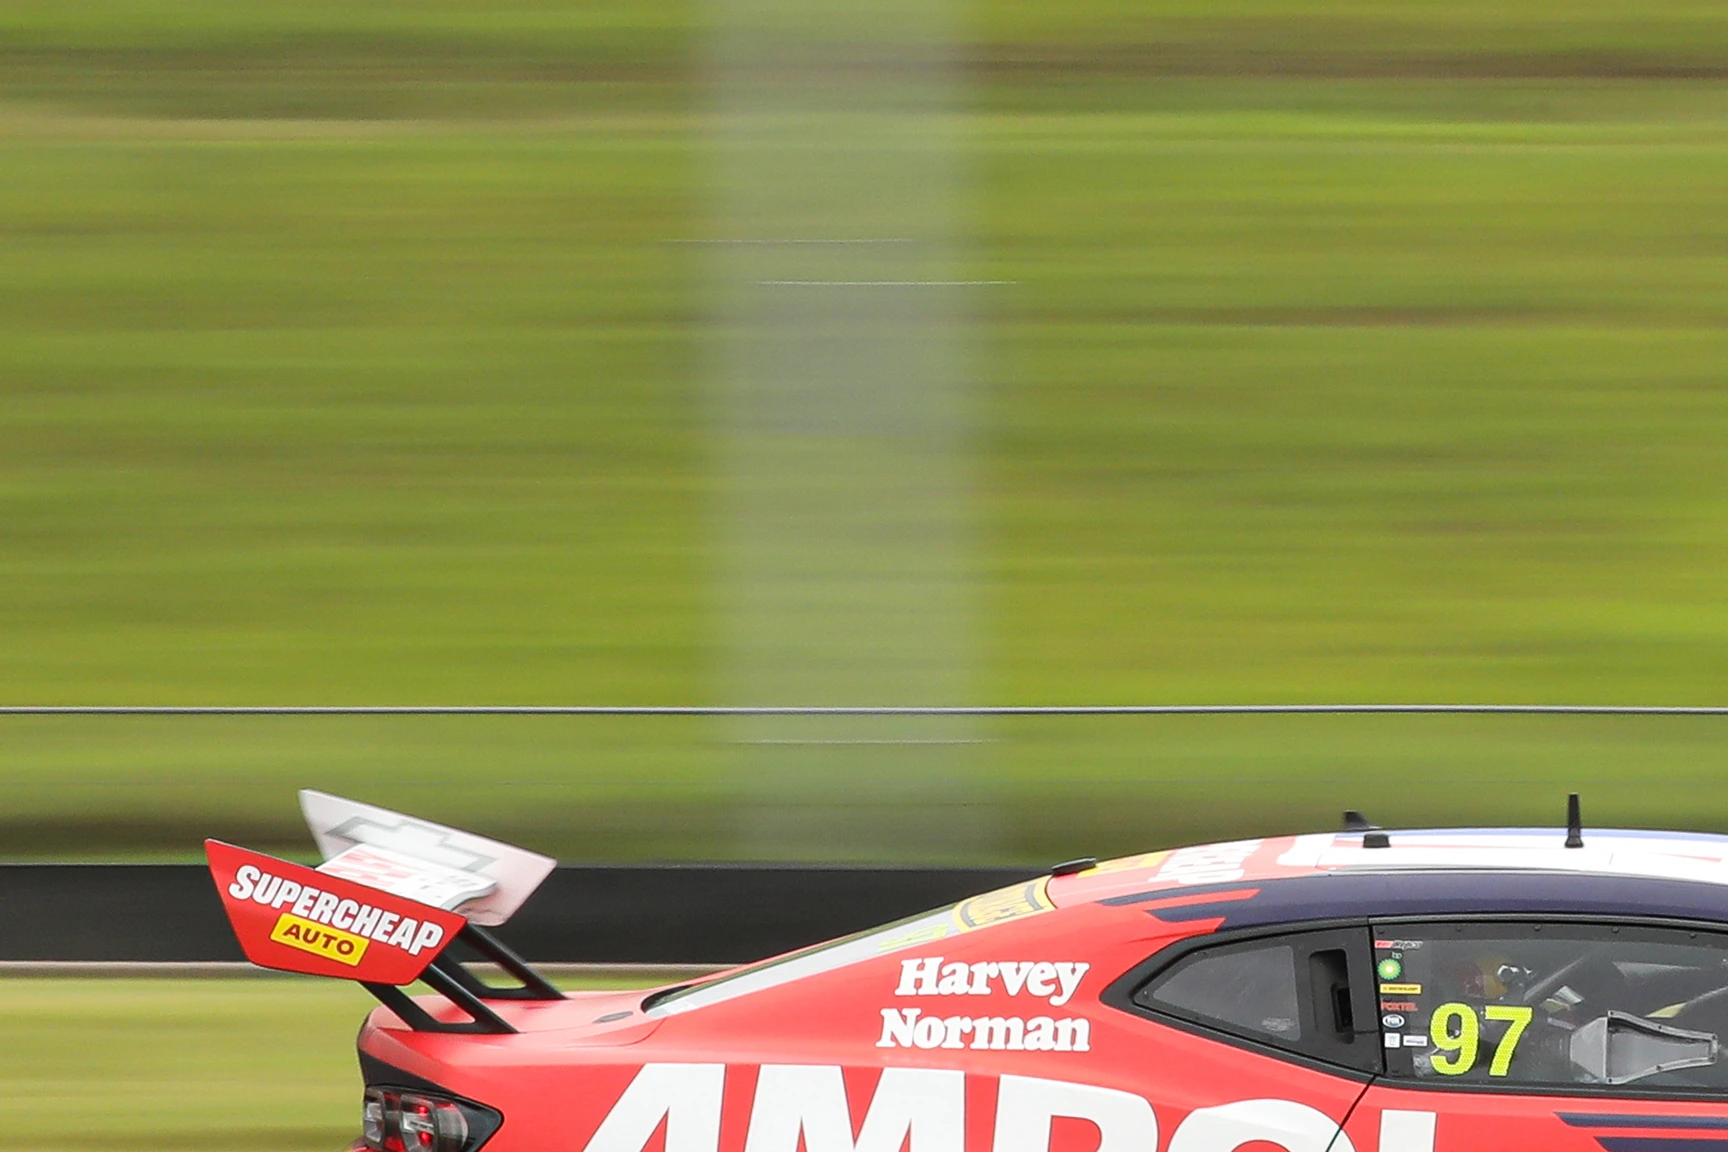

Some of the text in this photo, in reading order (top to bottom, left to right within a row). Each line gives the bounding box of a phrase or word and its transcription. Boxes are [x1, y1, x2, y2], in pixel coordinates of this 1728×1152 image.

[228, 865, 444, 956] SUPERCHEAP
[281, 922, 356, 957] AUTO
[894, 956, 1090, 1006] Harvey
[875, 1008, 1091, 1052] Norman
[1429, 1002, 1534, 1077] 97
